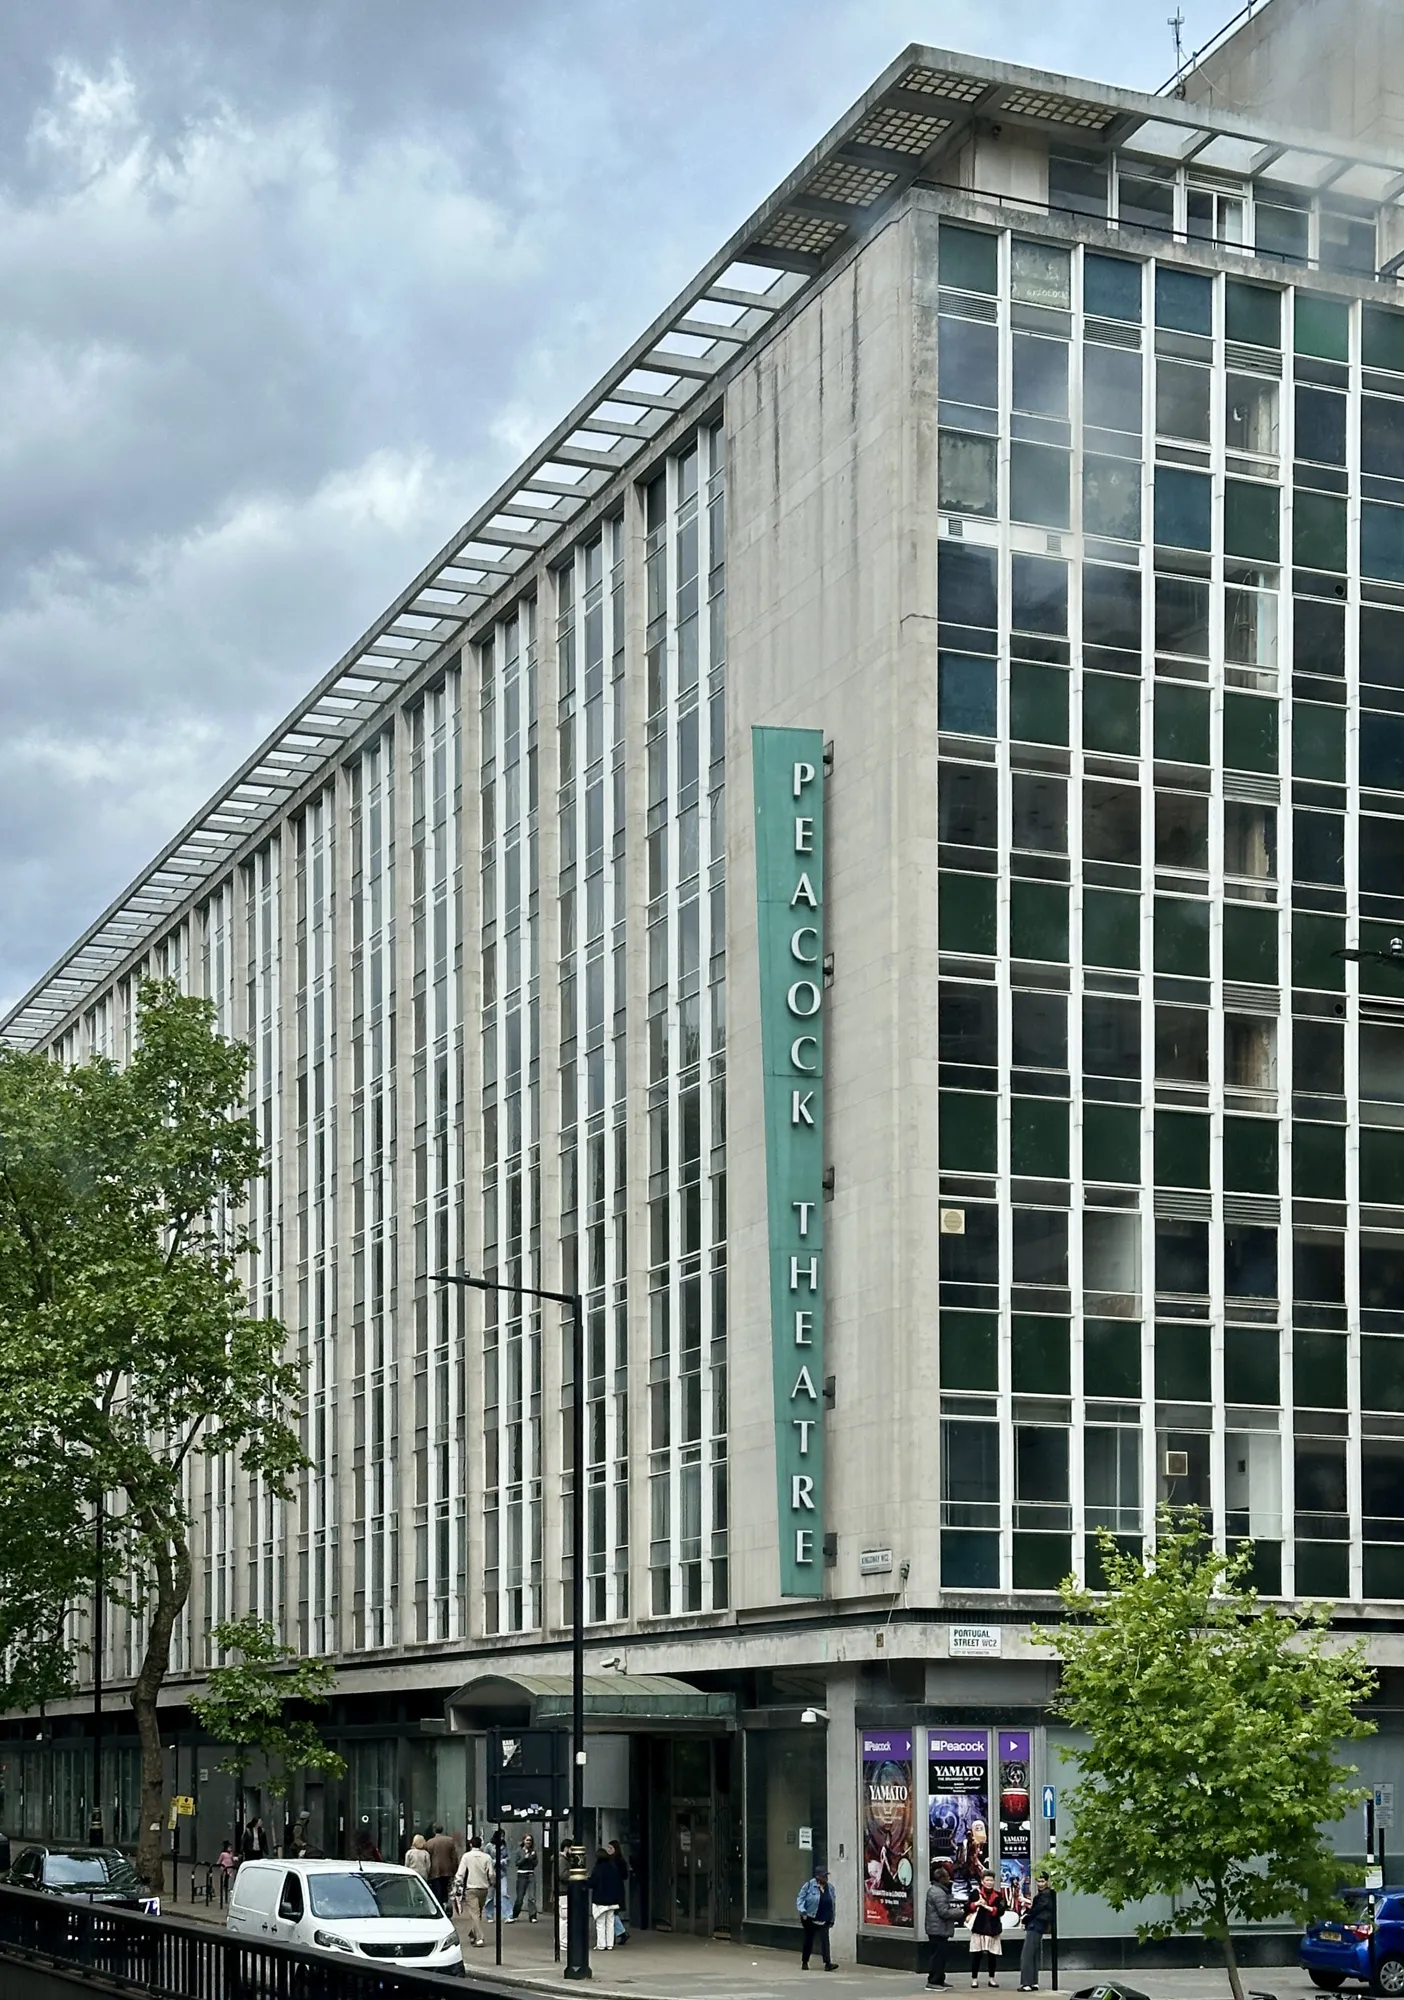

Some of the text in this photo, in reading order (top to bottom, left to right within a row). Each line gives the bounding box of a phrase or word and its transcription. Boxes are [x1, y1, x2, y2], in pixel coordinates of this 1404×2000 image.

[787, 762, 821, 1563] PEACOCK THEATRE
[953, 1629, 990, 1638] PORTUGAL
[953, 1638, 998, 1647] STREET WC2
[940, 1740, 985, 1752] Peacock
[933, 1765, 985, 1777] YAMATO
[869, 1784, 908, 1801] YAMATO
